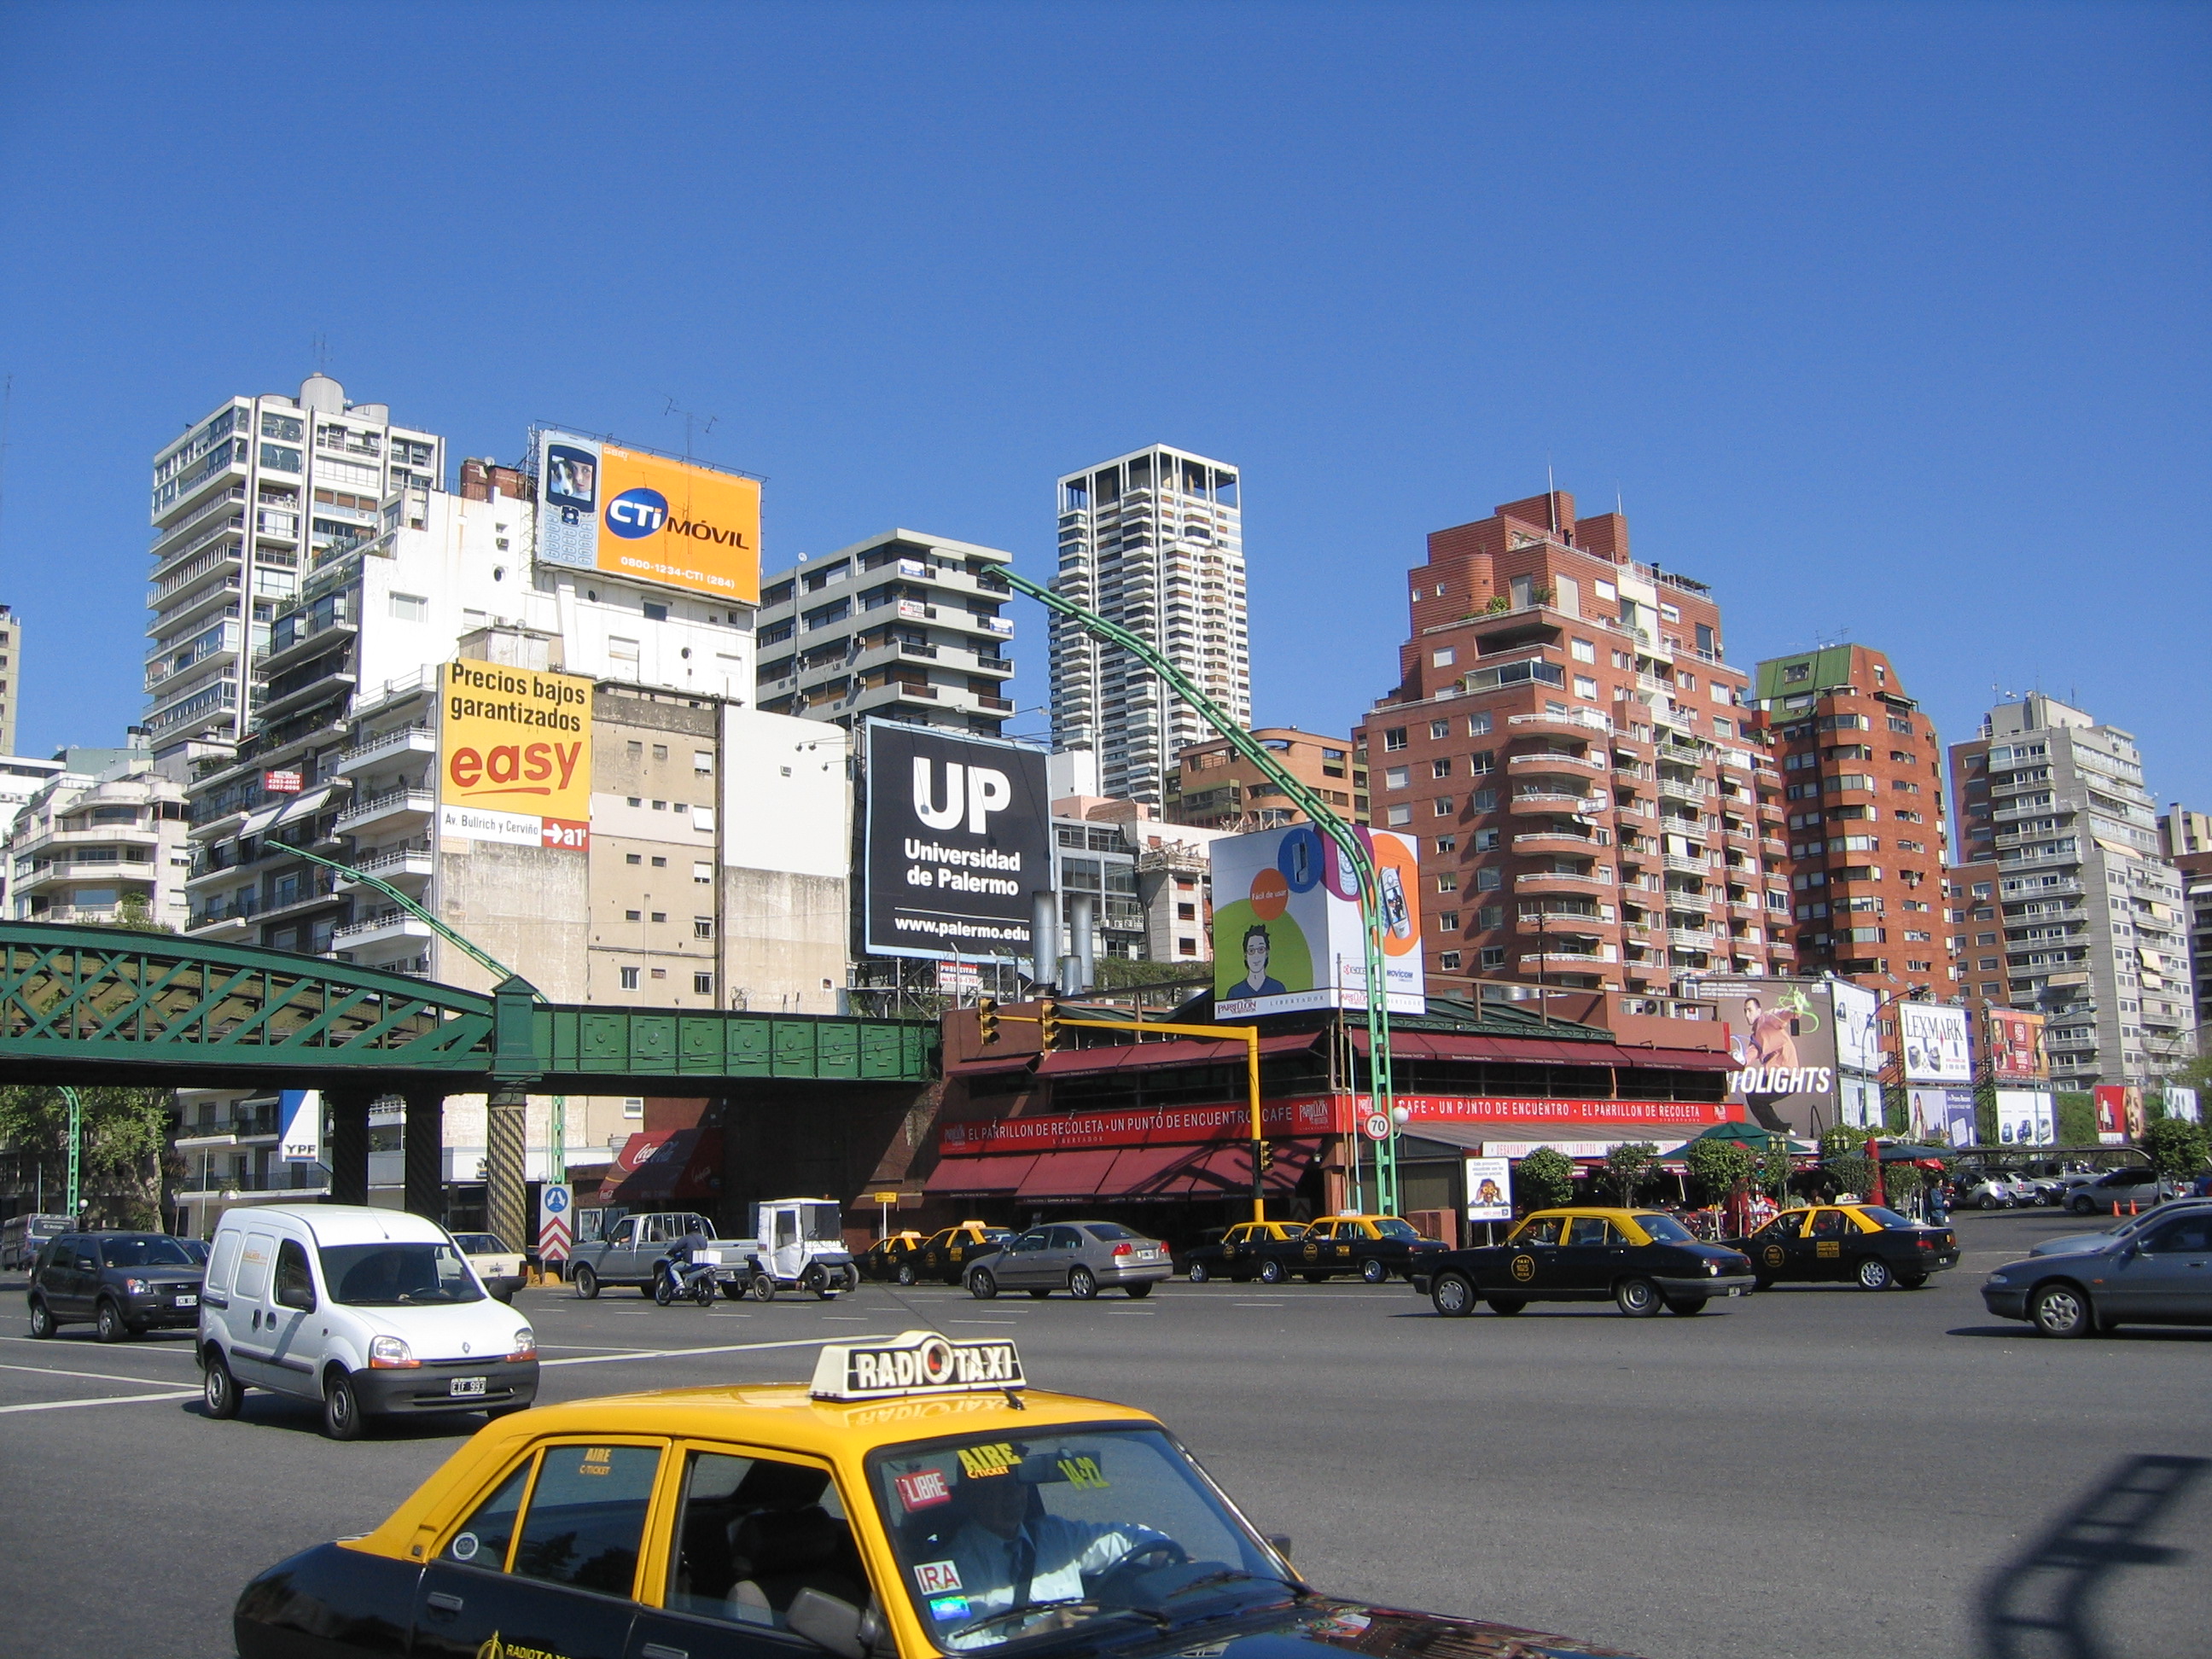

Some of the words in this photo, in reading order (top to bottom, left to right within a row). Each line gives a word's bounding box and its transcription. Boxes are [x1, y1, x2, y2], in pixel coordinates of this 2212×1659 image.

[667, 517, 749, 550] MÓVIL
[620, 556, 703, 581] 0800-1234-CTI
[707, 574, 736, 589] (284)
[451, 662, 527, 696] Precios
[533, 676, 585, 707] bajos
[451, 696, 580, 732] garantizados
[450, 742, 582, 790] easy
[913, 756, 1011, 835] UP
[445, 813, 458, 825] Av.
[462, 815, 496, 830] Bullrich
[498, 823, 504, 834] y
[506, 820, 538, 835] Cerviño
[905, 838, 1021, 871] Universidad
[906, 865, 934, 888] de
[939, 869, 1019, 896] Palermo
[894, 917, 1030, 941] www.palermo.edu
[1904, 1010, 1964, 1042] LEXMARK
[969, 1127, 980, 1140] EL
[981, 1124, 1033, 1139] PARRILLON
[1035, 1122, 1049, 1136] DE
[1051, 1120, 1104, 1135] RECOLETA
[1110, 1118, 1125, 1132] UN
[1127, 1115, 1163, 1131] PUNTO
[1166, 1114, 1180, 1127] DE
[1262, 1107, 1293, 1122] CAFE
[1439, 1101, 1452, 1115] UN
[1495, 1102, 1508, 1115] DE
[1512, 1102, 1569, 1116] ENCUENTRO
[1582, 1103, 1594, 1117] EL
[1595, 1103, 1643, 1117] PARRILLON
[1645, 1105, 1656, 1117] DE
[1659, 1105, 1700, 1117] RECOLETA
[1371, 1120, 1386, 1132] 70
[285, 1144, 317, 1154] YPF
[585, 1447, 612, 1463] AIRE
[957, 1443, 1022, 1471] AIRE
[905, 1472, 948, 1502] LIBRE
[967, 1465, 1010, 1479] C/TICKET
[917, 1564, 960, 1592] IRA
[506, 1644, 571, 1659] RADIOTA
